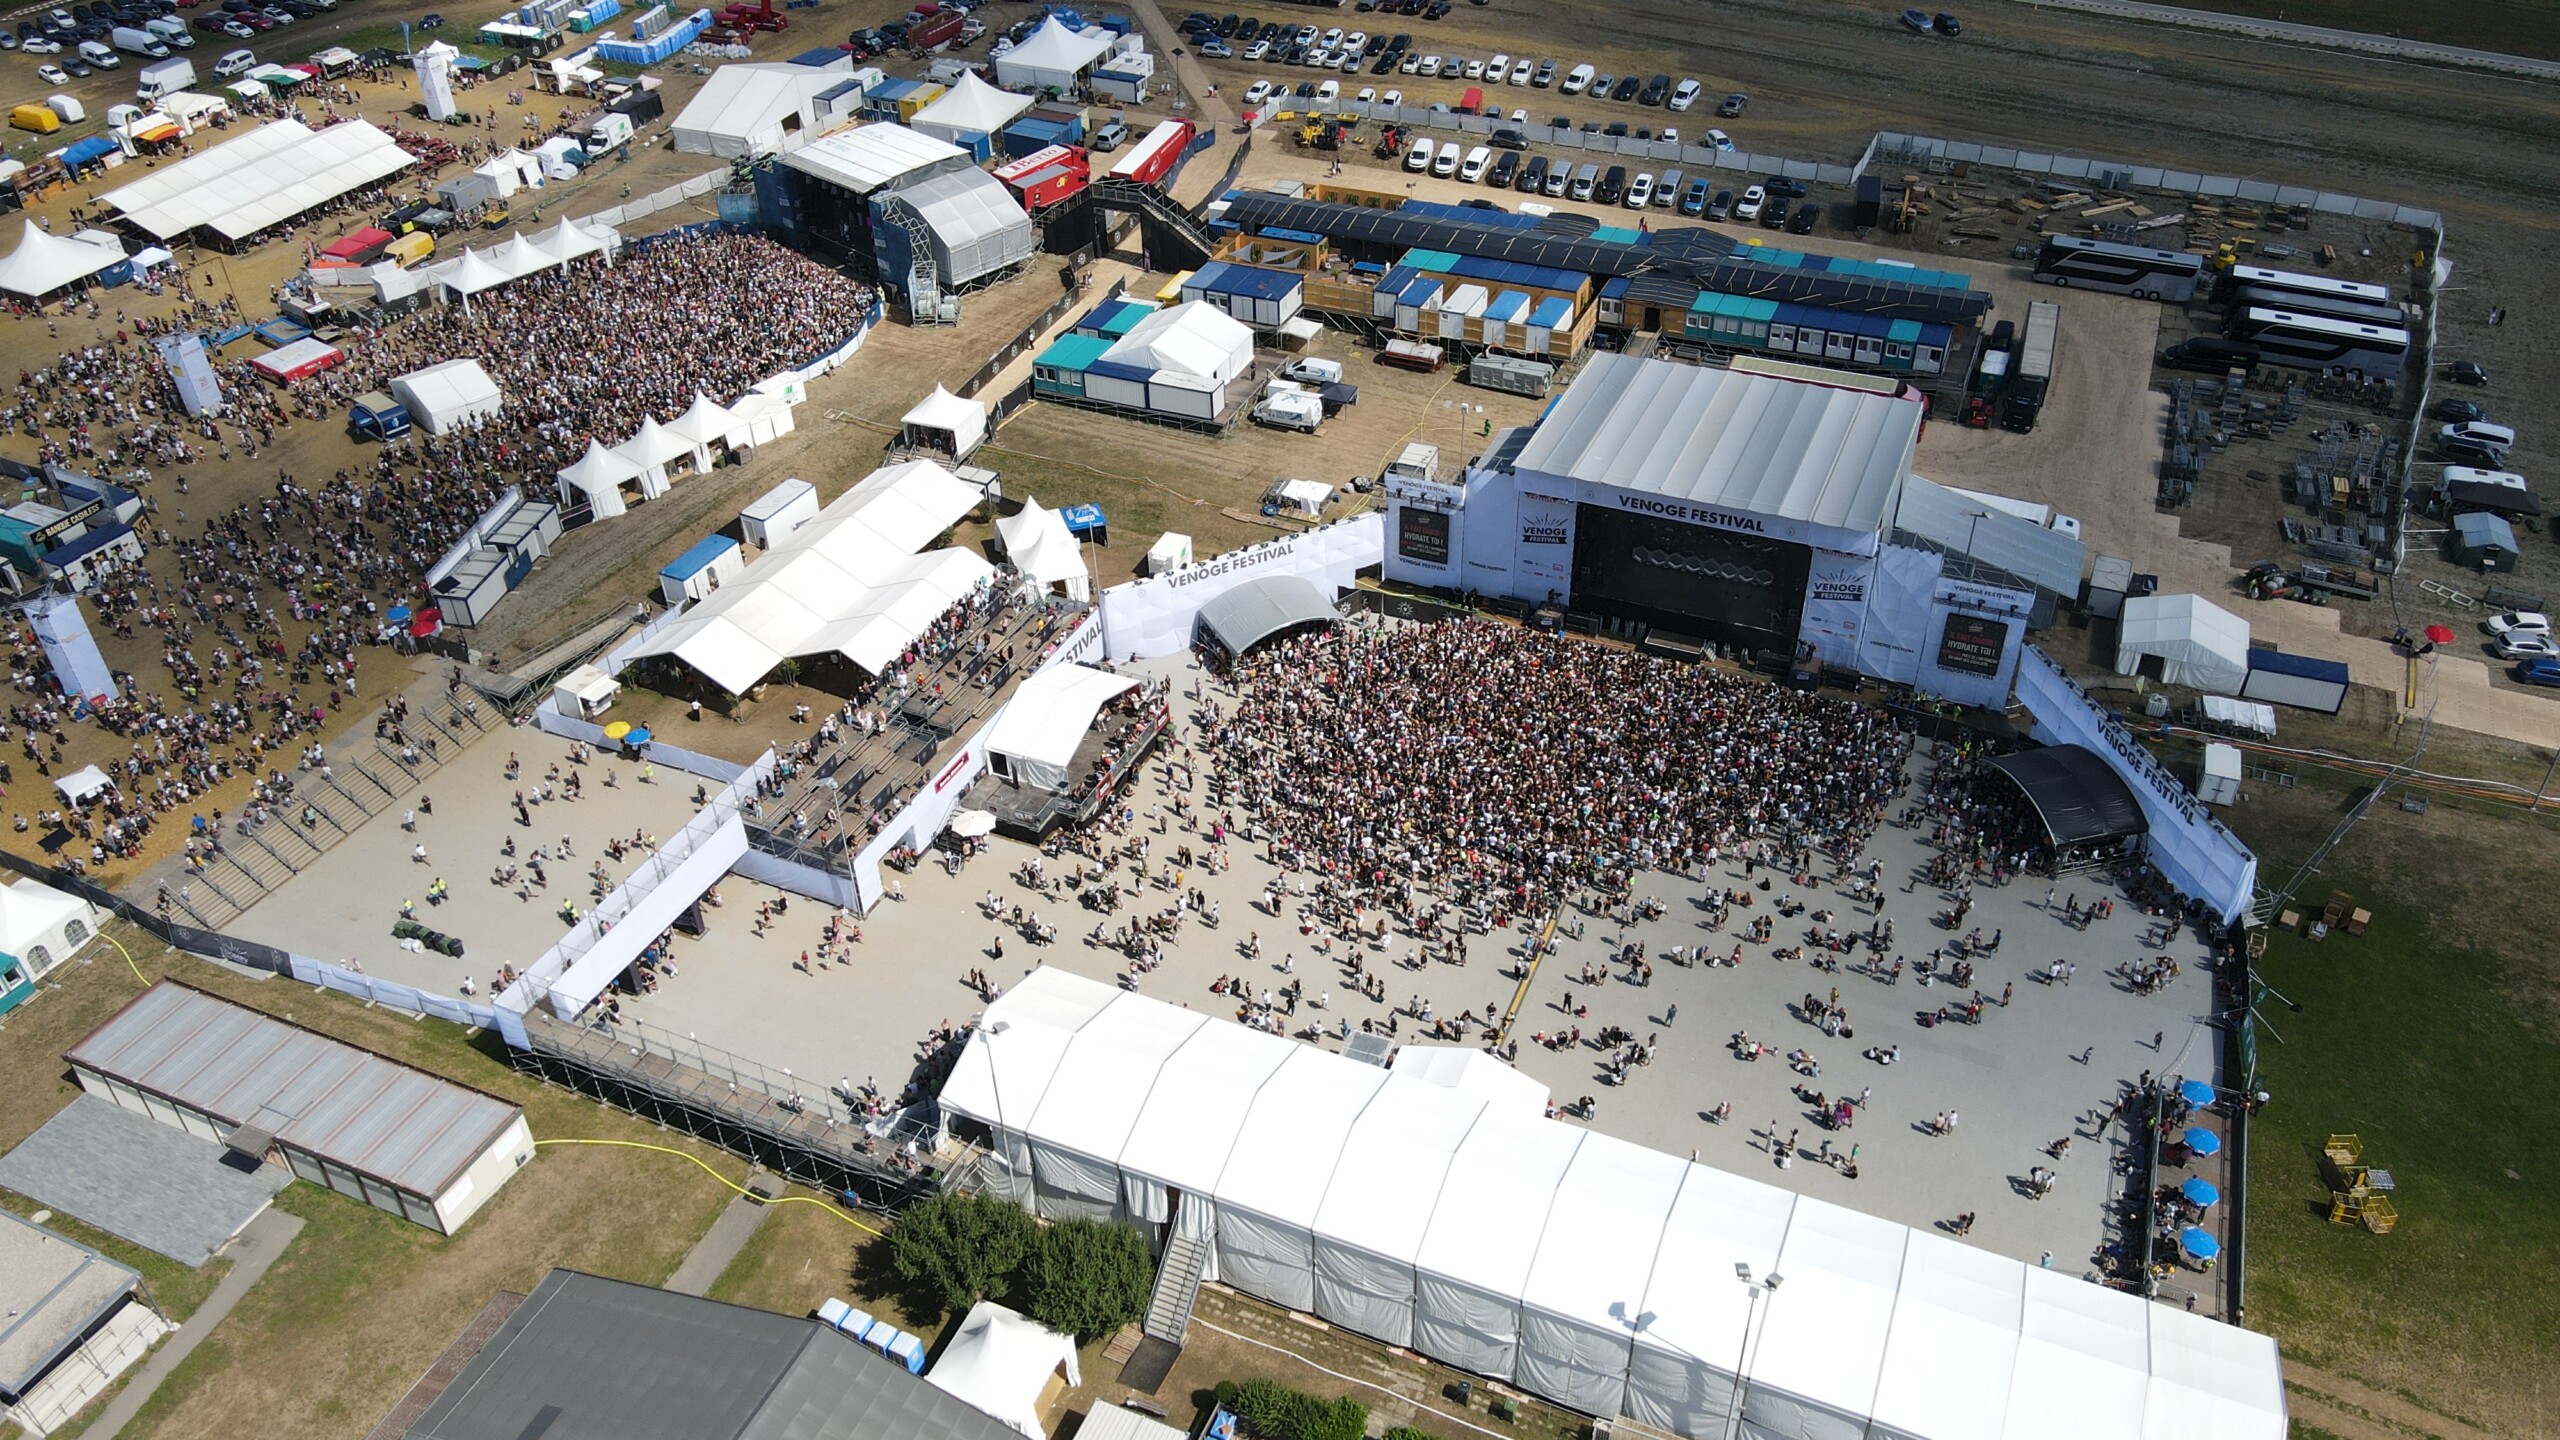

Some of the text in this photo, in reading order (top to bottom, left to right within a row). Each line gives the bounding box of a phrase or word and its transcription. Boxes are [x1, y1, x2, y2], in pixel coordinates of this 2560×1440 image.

[45, 503, 100, 537] BANQUE CASHLESS
[1618, 494, 1765, 532] VENOGE FESTIVAL
[133, 517, 149, 535] VF
[1523, 526, 1567, 536] VENOGE
[1404, 531, 1430, 544] HYDRATE
[1168, 543, 1295, 589] VENOGE FESTIVAL
[1814, 582, 1864, 593] VENOGE
[1820, 592, 1854, 600] FESTIVAL
[1954, 585, 2016, 600] VENOGE FESTIVAL
[1056, 621, 1103, 664] STIVAL
[1947, 640, 1979, 654] HYDRATE
[1980, 647, 1991, 656] TOI
[2097, 719, 2195, 827] VENOGE FESTIVAL
